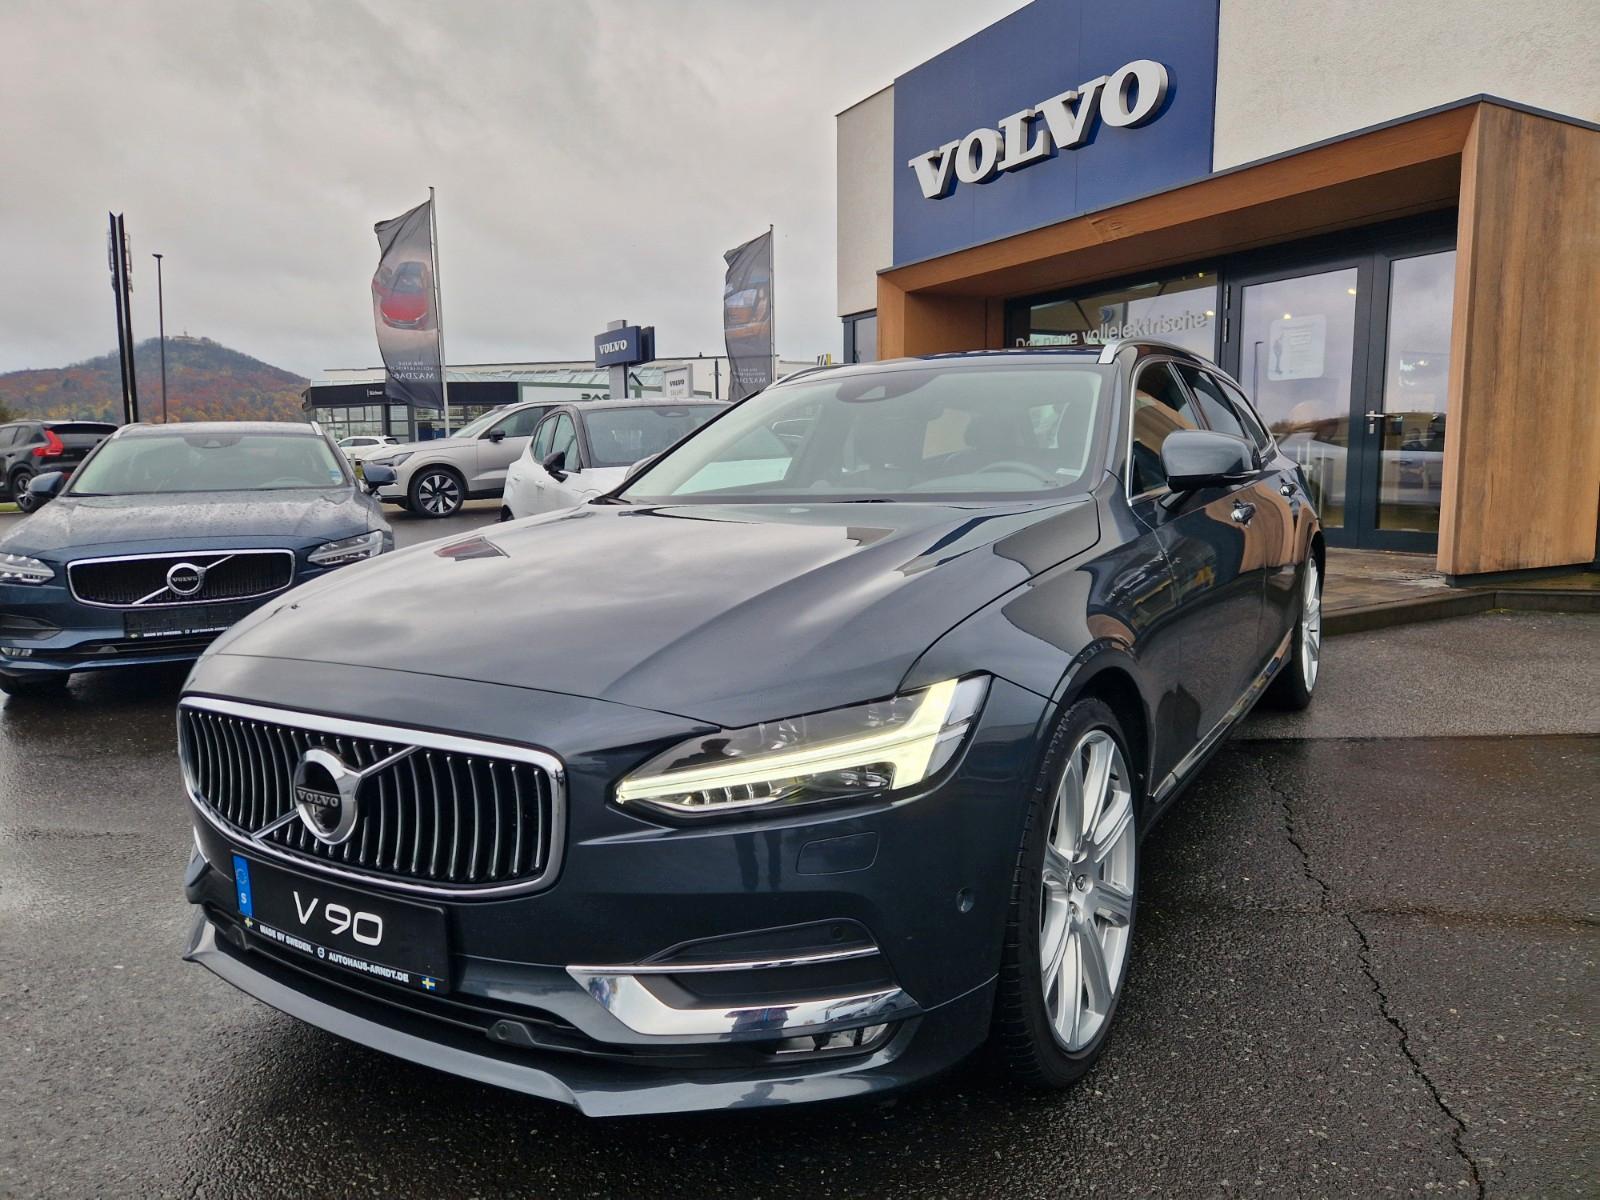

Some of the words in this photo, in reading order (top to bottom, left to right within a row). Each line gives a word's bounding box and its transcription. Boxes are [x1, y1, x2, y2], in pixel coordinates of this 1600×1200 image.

[908, 59, 1169, 199] VOLVO
[1082, 310, 1209, 344] vollelektrische
[599, 339, 627, 355] VOLVO
[297, 790, 339, 807] VOLVO
[240, 892, 248, 904] S
[293, 891, 319, 925] V
[325, 903, 383, 946] 90
[328, 952, 409, 983] AUTOHAUS-ARNDT.DE
